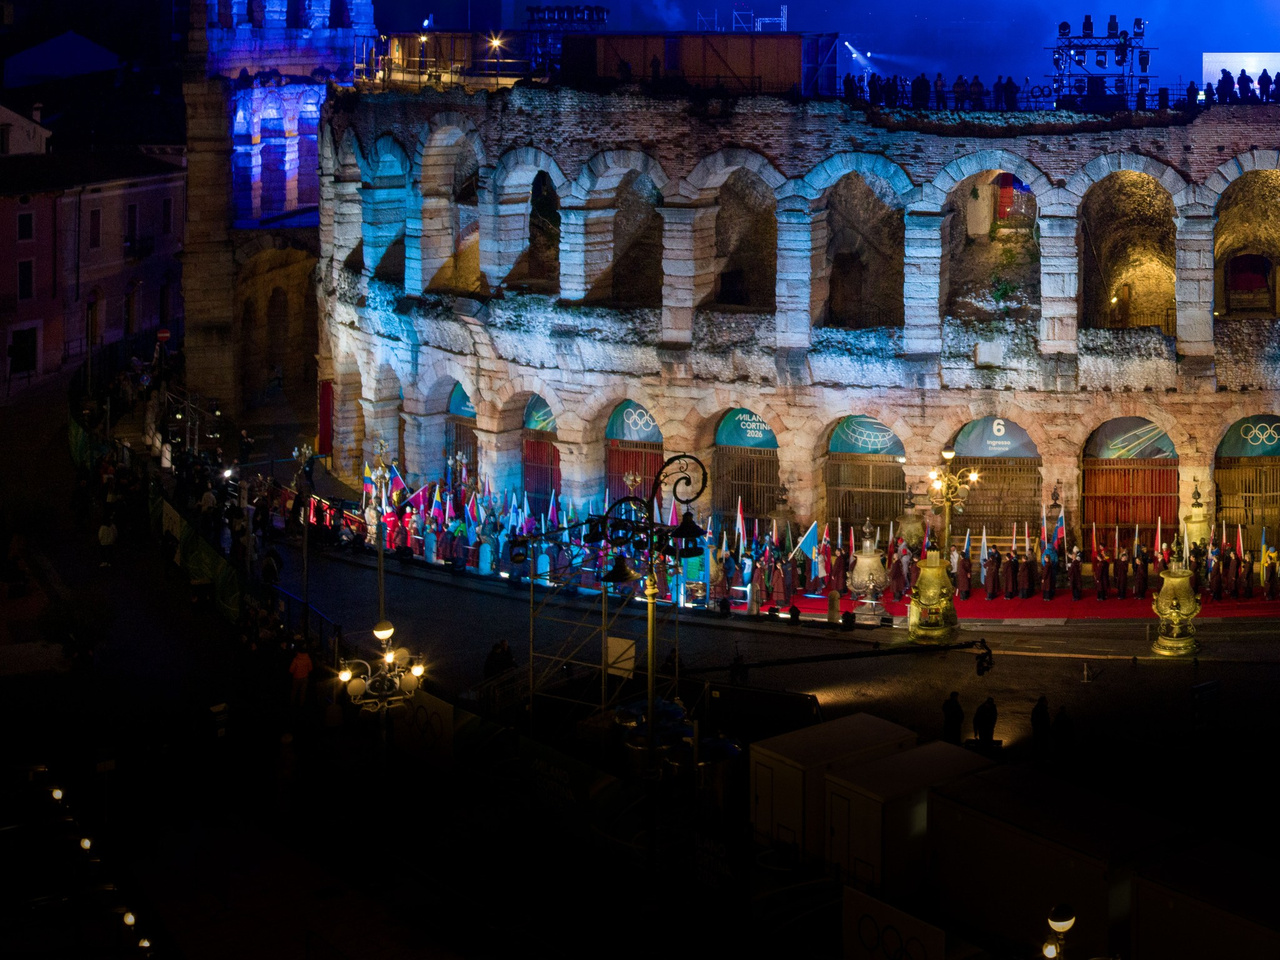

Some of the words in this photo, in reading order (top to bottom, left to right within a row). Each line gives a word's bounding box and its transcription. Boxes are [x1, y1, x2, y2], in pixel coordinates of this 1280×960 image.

[735, 414, 763, 423] MILAN
[992, 419, 1006, 437] 6
[746, 430, 763, 438] 2026
